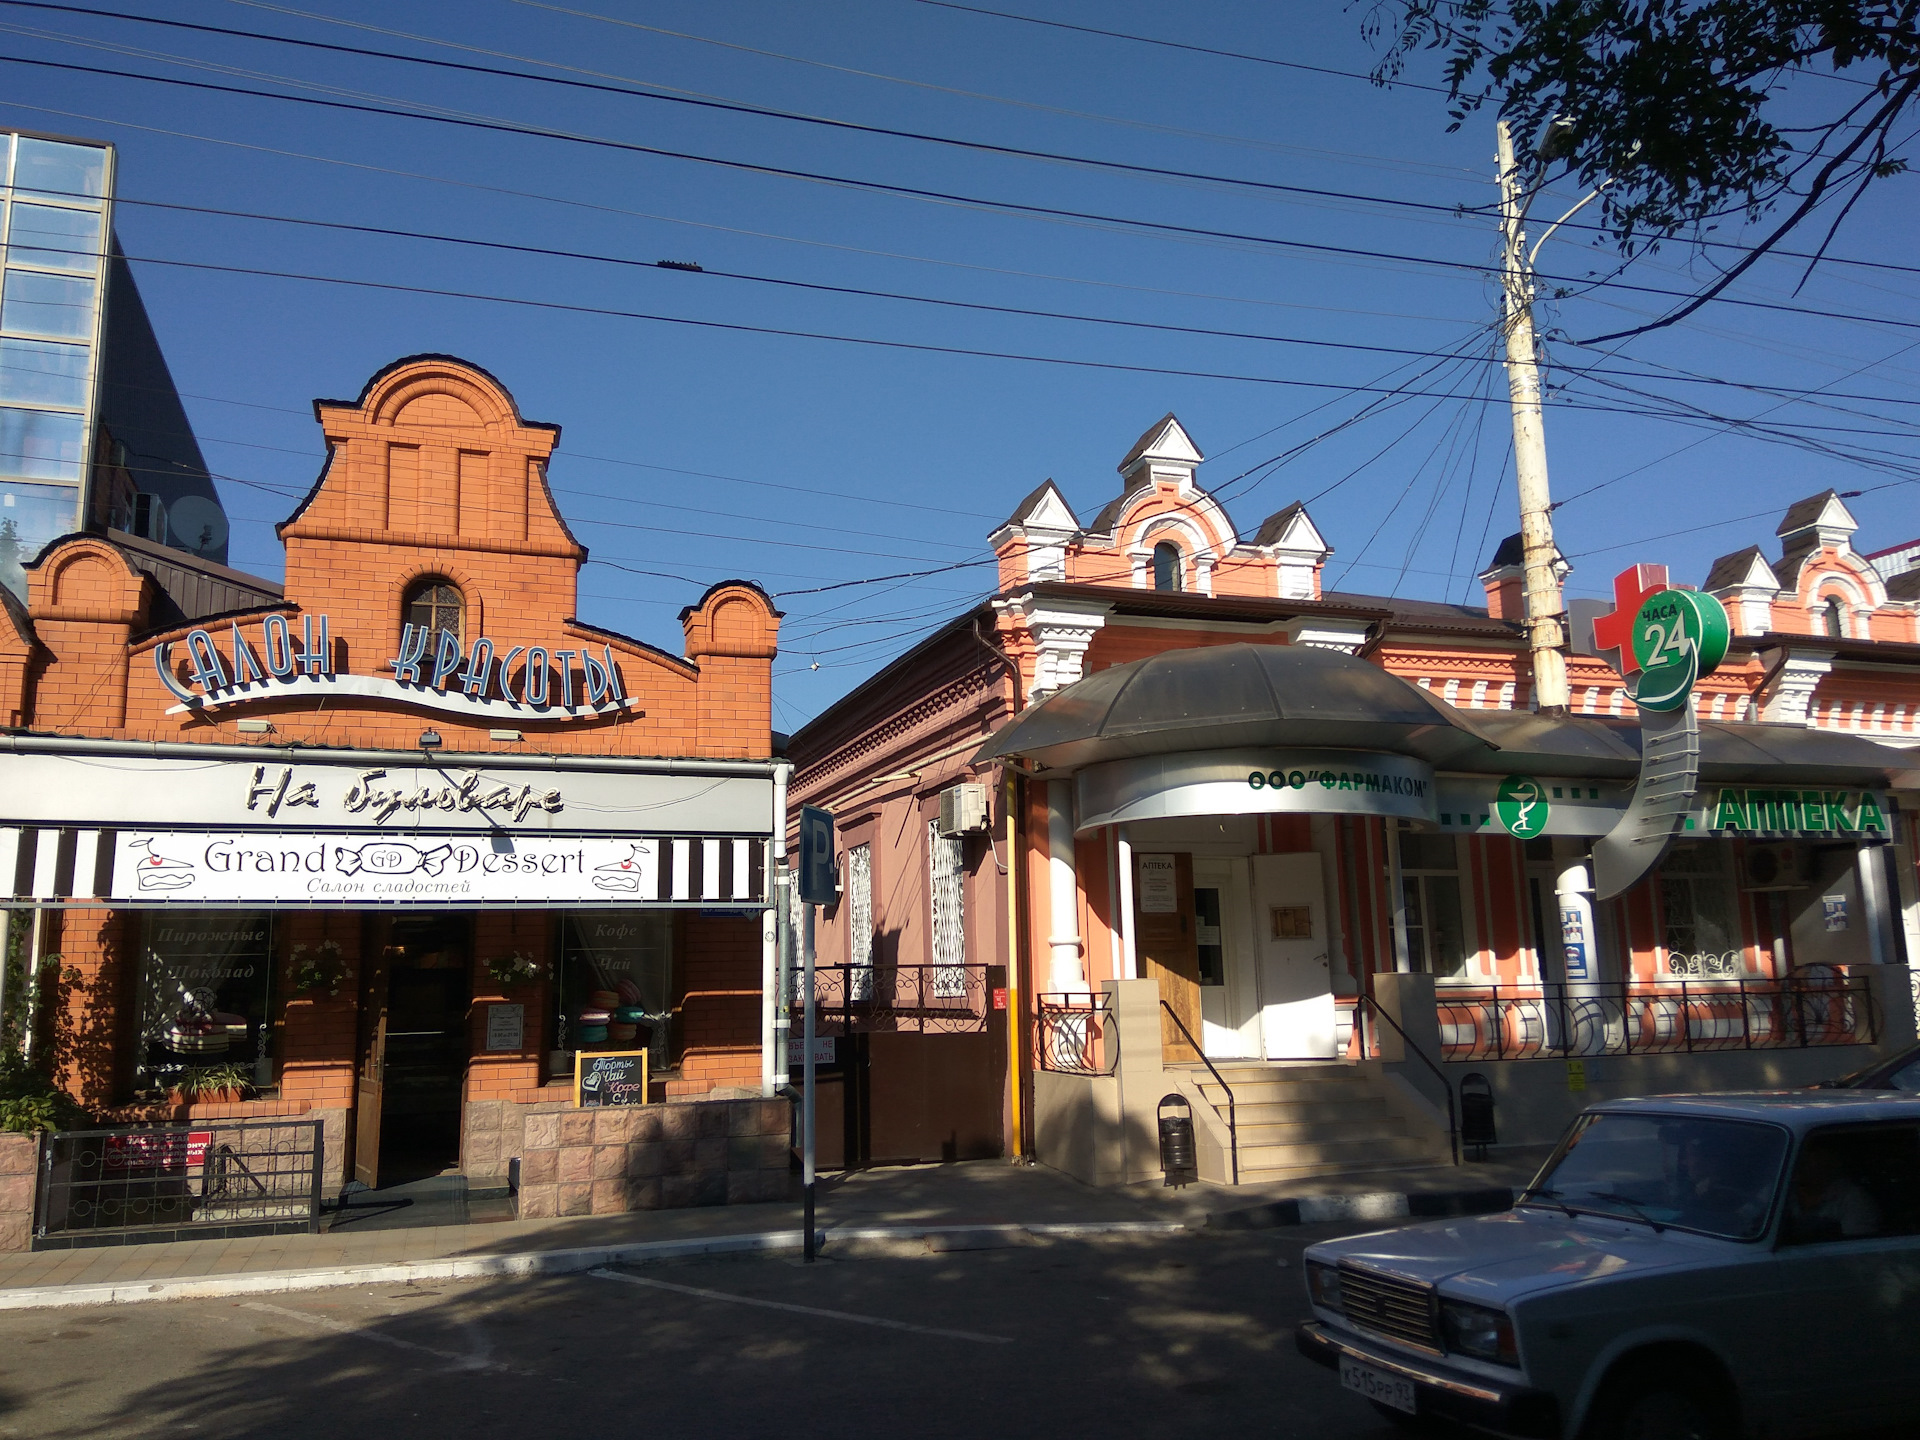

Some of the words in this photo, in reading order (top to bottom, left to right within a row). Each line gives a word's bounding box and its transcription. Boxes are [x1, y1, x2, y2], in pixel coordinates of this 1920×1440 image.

[1642, 604, 1677, 621] ЧАСА
[1644, 609, 1692, 667] 24
[155, 614, 329, 703] САЛОН
[389, 622, 622, 707] КРАСОТЫ
[246, 764, 319, 818] На
[1712, 788, 1887, 831] АПТЕКА
[204, 840, 326, 874] Grand
[452, 844, 585, 875] Dessert
[371, 850, 402, 868] GD
[812, 819, 830, 891] P
[1142, 862, 1173, 870] АПТЕКА
[306, 877, 365, 893] Салон
[373, 878, 472, 894] сладостей
[157, 928, 265, 946] Пирожные
[595, 924, 637, 940] Кофе
[165, 964, 254, 979] Шоколад
[600, 957, 631, 971] Чай
[822, 1040, 833, 1049] НЕ
[593, 1057, 634, 1075] Торты
[788, 1052, 834, 1063] ЗАКВАТЬ
[602, 1069, 627, 1082] Чай
[605, 1081, 640, 1099] Кофе
